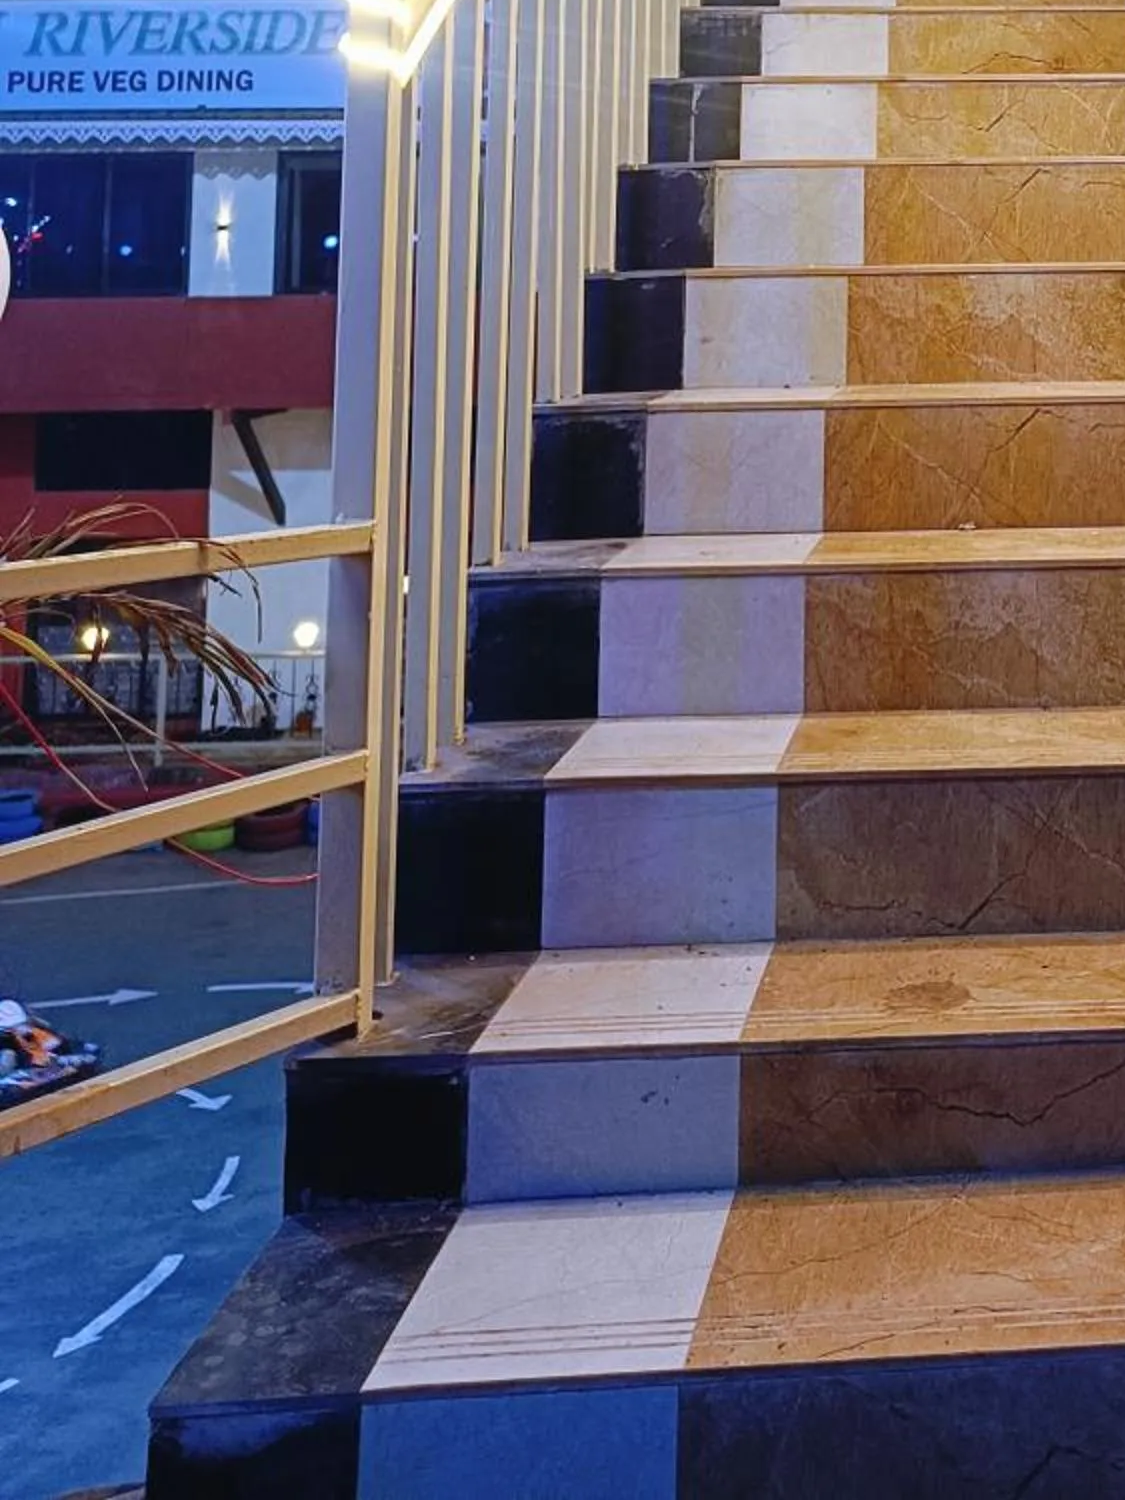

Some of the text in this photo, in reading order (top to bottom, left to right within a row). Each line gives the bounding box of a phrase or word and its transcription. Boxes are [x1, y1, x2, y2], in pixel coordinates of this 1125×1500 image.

[23, 9, 346, 57] RIVERSIDE
[7, 69, 254, 93] PURE VEG DINING
